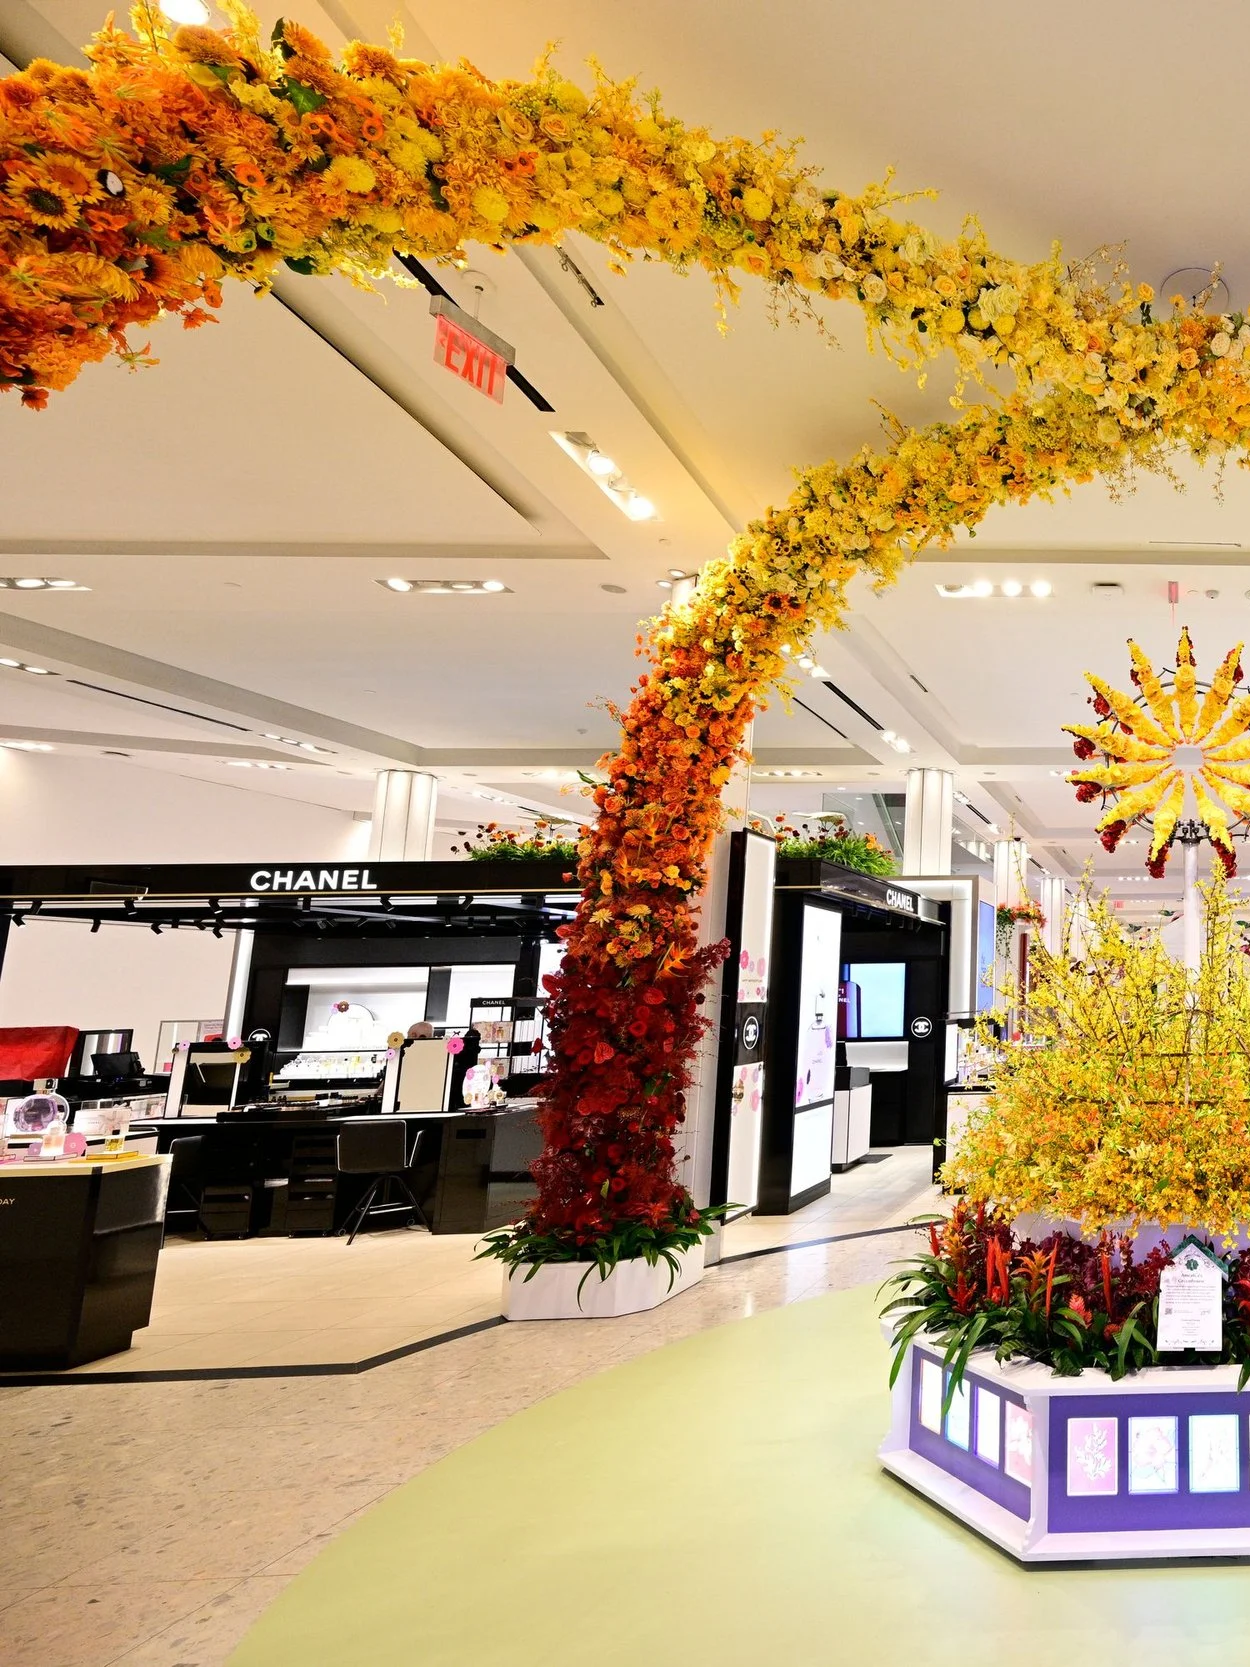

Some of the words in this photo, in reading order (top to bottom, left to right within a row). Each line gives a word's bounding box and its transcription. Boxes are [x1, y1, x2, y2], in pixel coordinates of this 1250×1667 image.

[445, 331, 498, 395] EXIT
[250, 869, 378, 891] CHANEL
[886, 889, 914, 912] CHANEL
